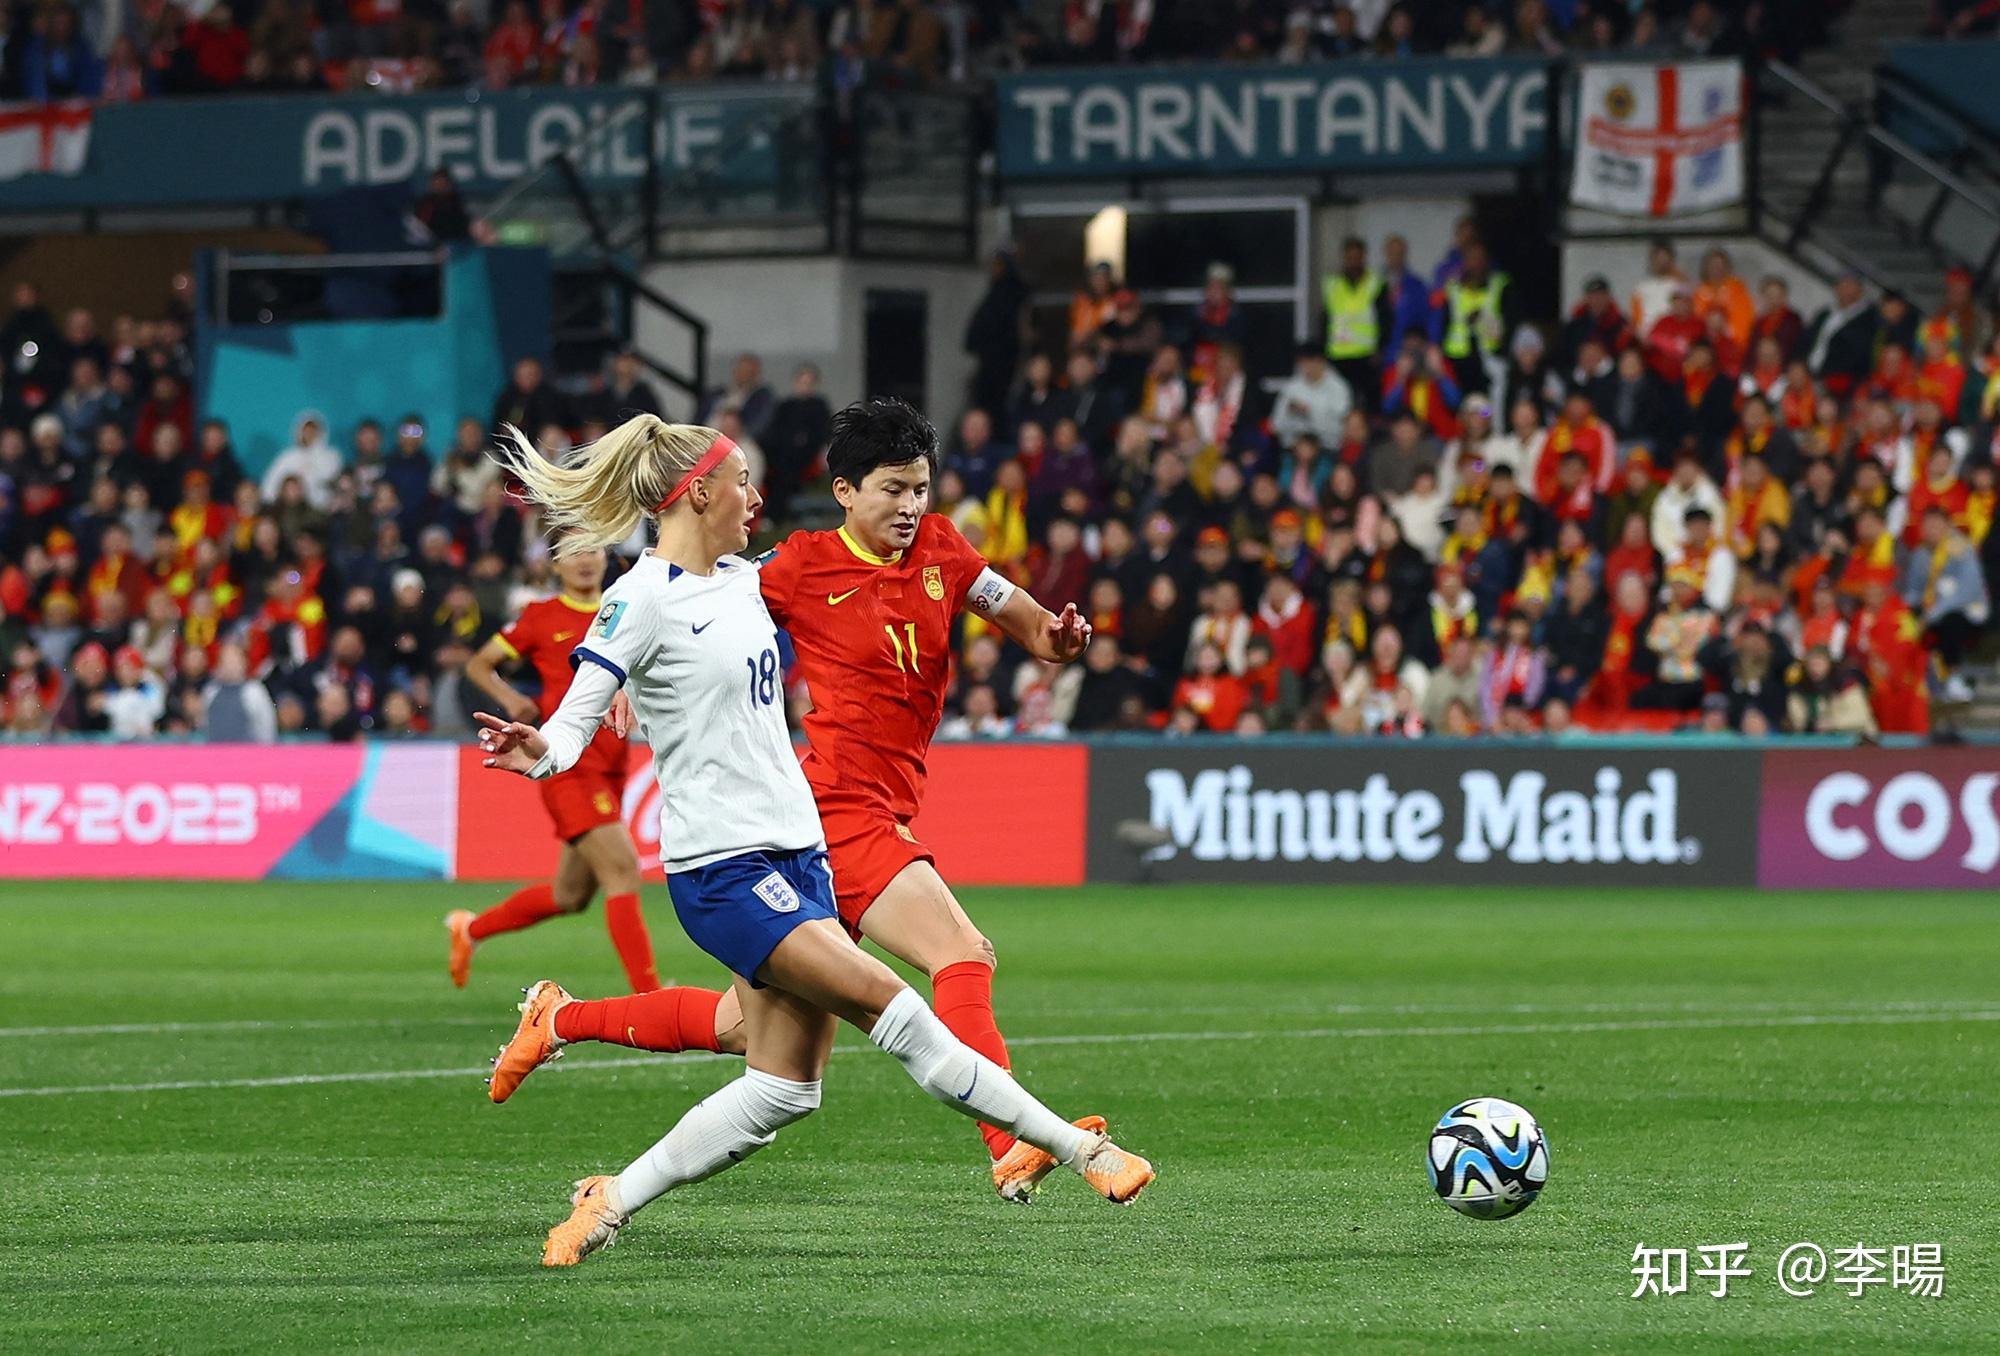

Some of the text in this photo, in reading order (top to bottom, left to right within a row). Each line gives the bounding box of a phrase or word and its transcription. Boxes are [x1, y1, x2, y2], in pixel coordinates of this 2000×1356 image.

[747, 648, 776, 711] 18
[884, 622, 922, 675] 11
[1146, 765, 1444, 863] Minute
